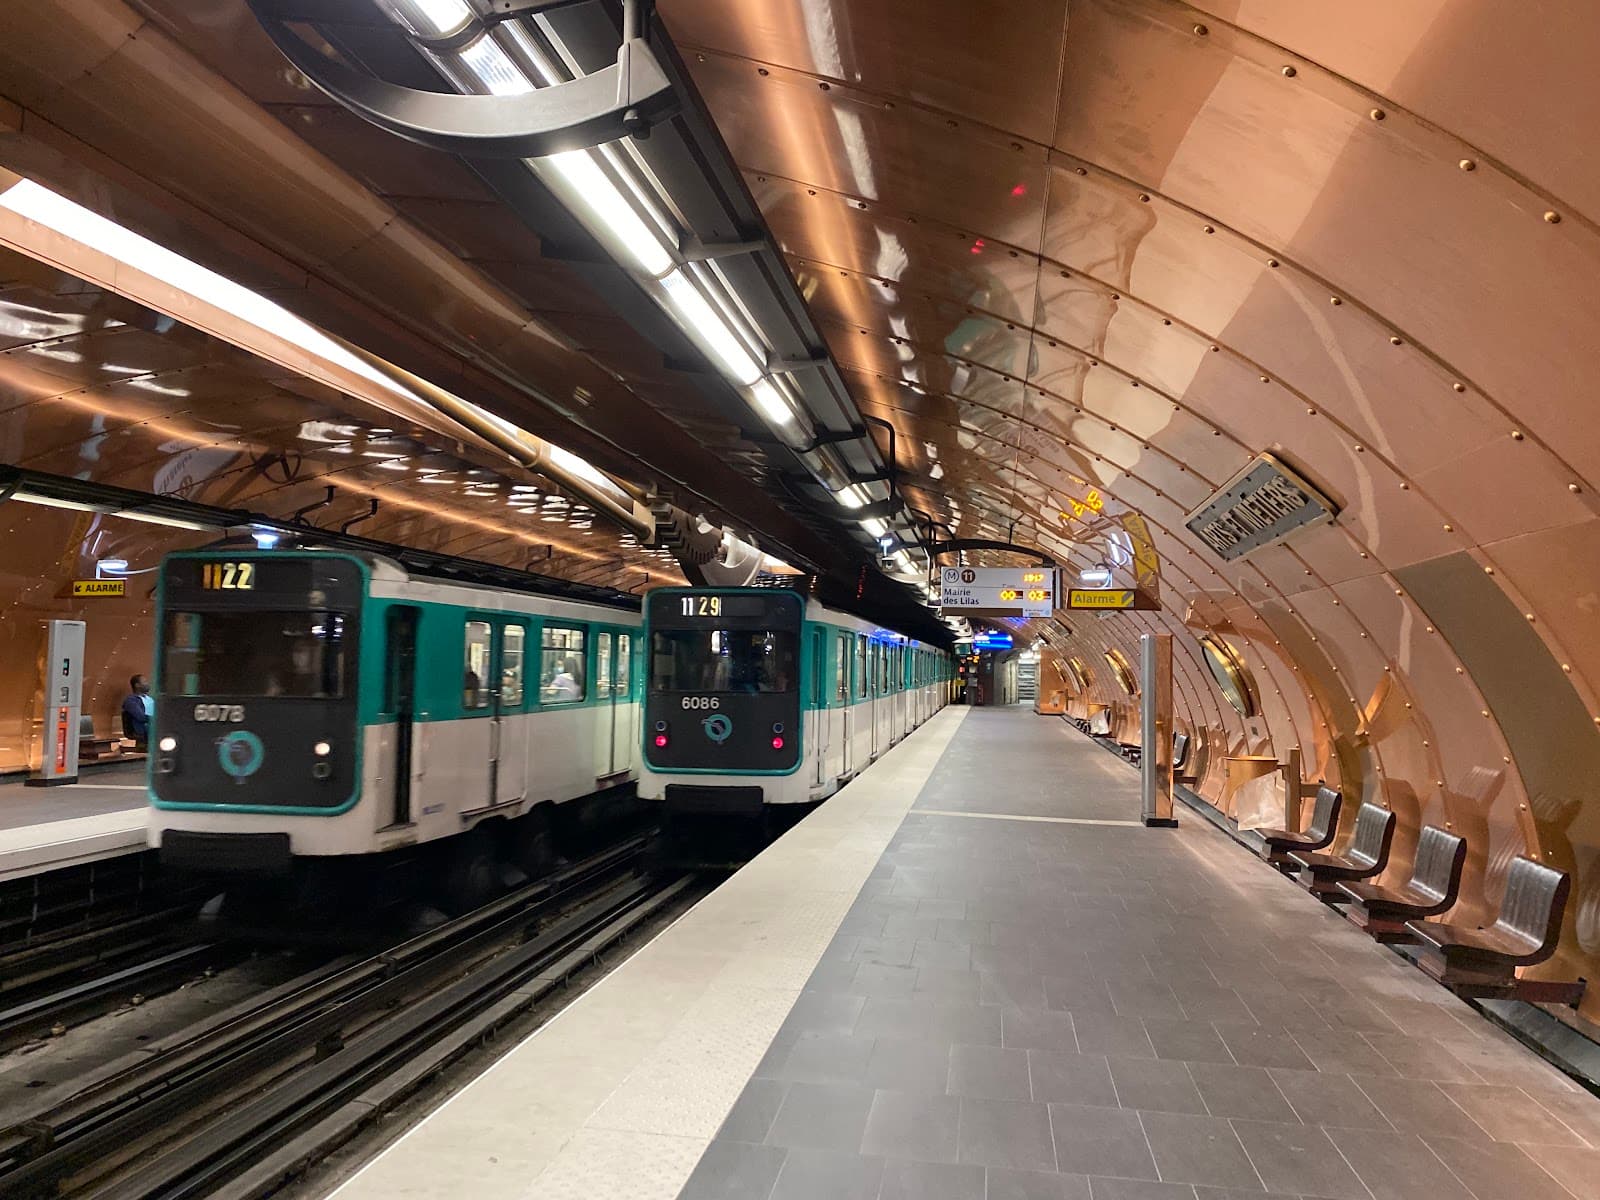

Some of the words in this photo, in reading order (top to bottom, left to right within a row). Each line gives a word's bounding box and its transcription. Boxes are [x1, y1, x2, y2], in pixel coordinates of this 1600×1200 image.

[962, 571, 974, 581] 11
[85, 584, 124, 593] ALARME
[943, 587, 971, 597] Mairie
[943, 596, 958, 605] des
[960, 596, 980, 605] Lilas
[1000, 590, 1017, 601] 00
[1028, 590, 1045, 601] 03
[1073, 593, 1116, 605] Alarme
[681, 696, 720, 710] 6086
